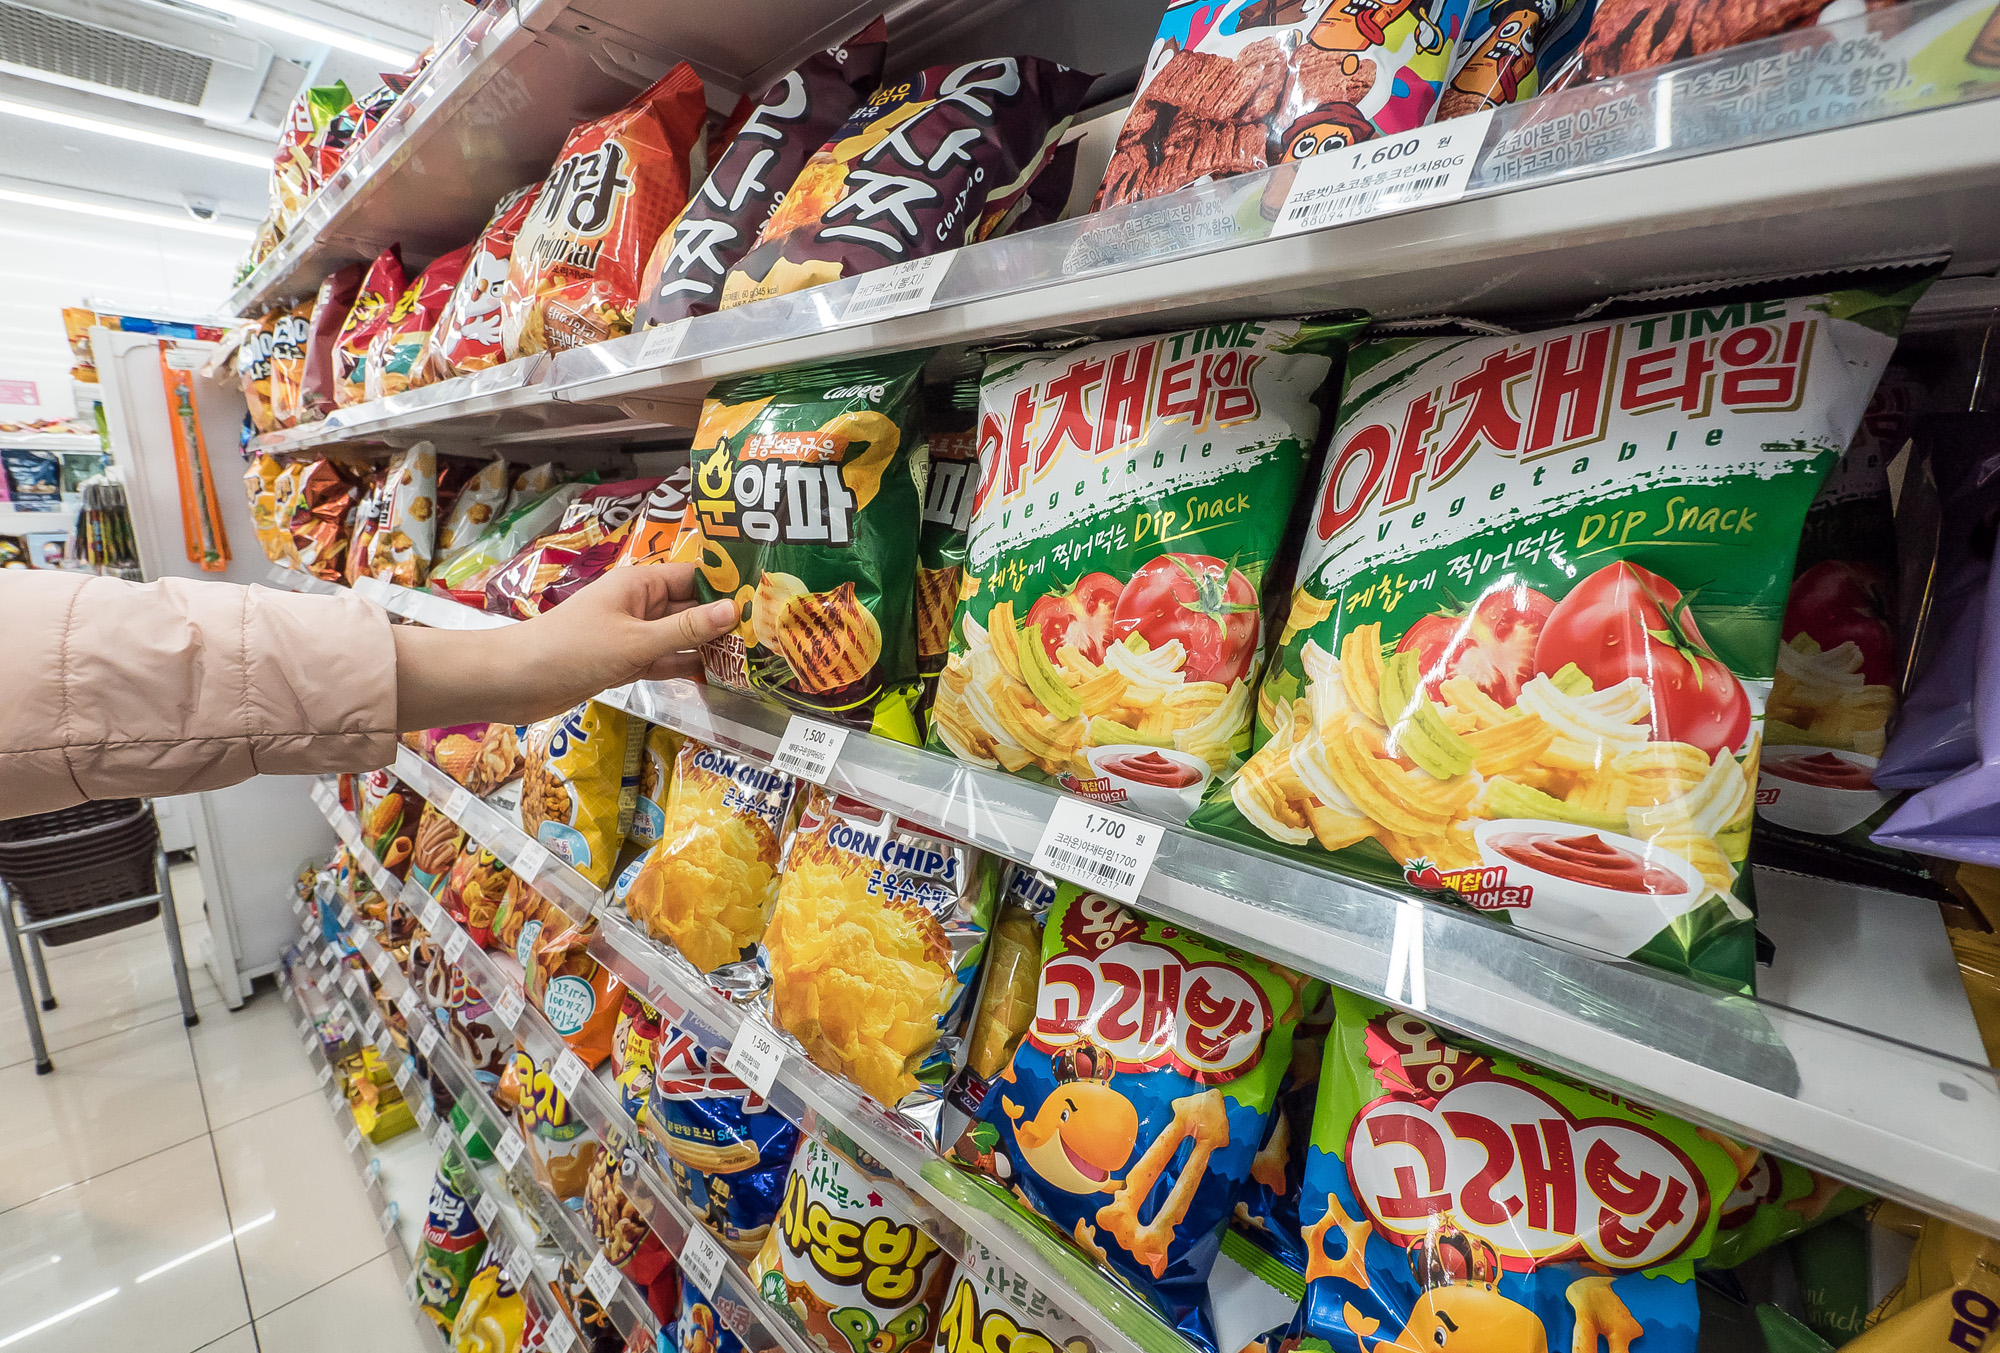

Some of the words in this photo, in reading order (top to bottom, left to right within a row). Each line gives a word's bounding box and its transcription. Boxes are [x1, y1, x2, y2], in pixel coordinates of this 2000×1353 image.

[1352, 139, 1420, 170] 1,600
[1437, 135, 1453, 149] 원
[1493, 118, 1574, 159] 코코아분말
[530, 142, 629, 232] 게랑
[530, 232, 604, 271] Original
[1167, 321, 1270, 363] TIME
[1630, 301, 1787, 350] TIME
[690, 440, 853, 543] 운양파
[1000, 440, 1213, 529] Vegetable
[1377, 427, 1725, 543] Vegetable
[987, 557, 1046, 593] 케찹에
[1051, 521, 1128, 570] 찍어먹는
[1134, 509, 1176, 543] Dip
[1185, 492, 1251, 531] Snack
[1346, 567, 1437, 614] 케찹에
[1447, 525, 1567, 592] 찍어먹는
[1576, 506, 1641, 549] Dip
[1654, 496, 1758, 537] Snack
[803, 727, 826, 743] 1,500
[693, 750, 738, 778] CORN
[738, 765, 796, 799] CHIPS
[829, 823, 880, 858] CORN
[881, 840, 960, 882] CHIPS
[1054, 832, 1137, 869] 크라운)야채타임1700
[1085, 813, 1126, 839] 1,700
[1136, 834, 1146, 847] 원
[867, 869, 950, 916] 군옥수수맛
[1010, 866, 1056, 906] HIP
[1050, 859, 1120, 890] 8801111770217
[1441, 868, 1504, 893] 케찹이
[1035, 962, 1255, 1063] 고래밥
[752, 1035, 771, 1055] 1,500
[1366, 1109, 1688, 1259] 고래밥
[779, 1171, 944, 1299] 사또밥
